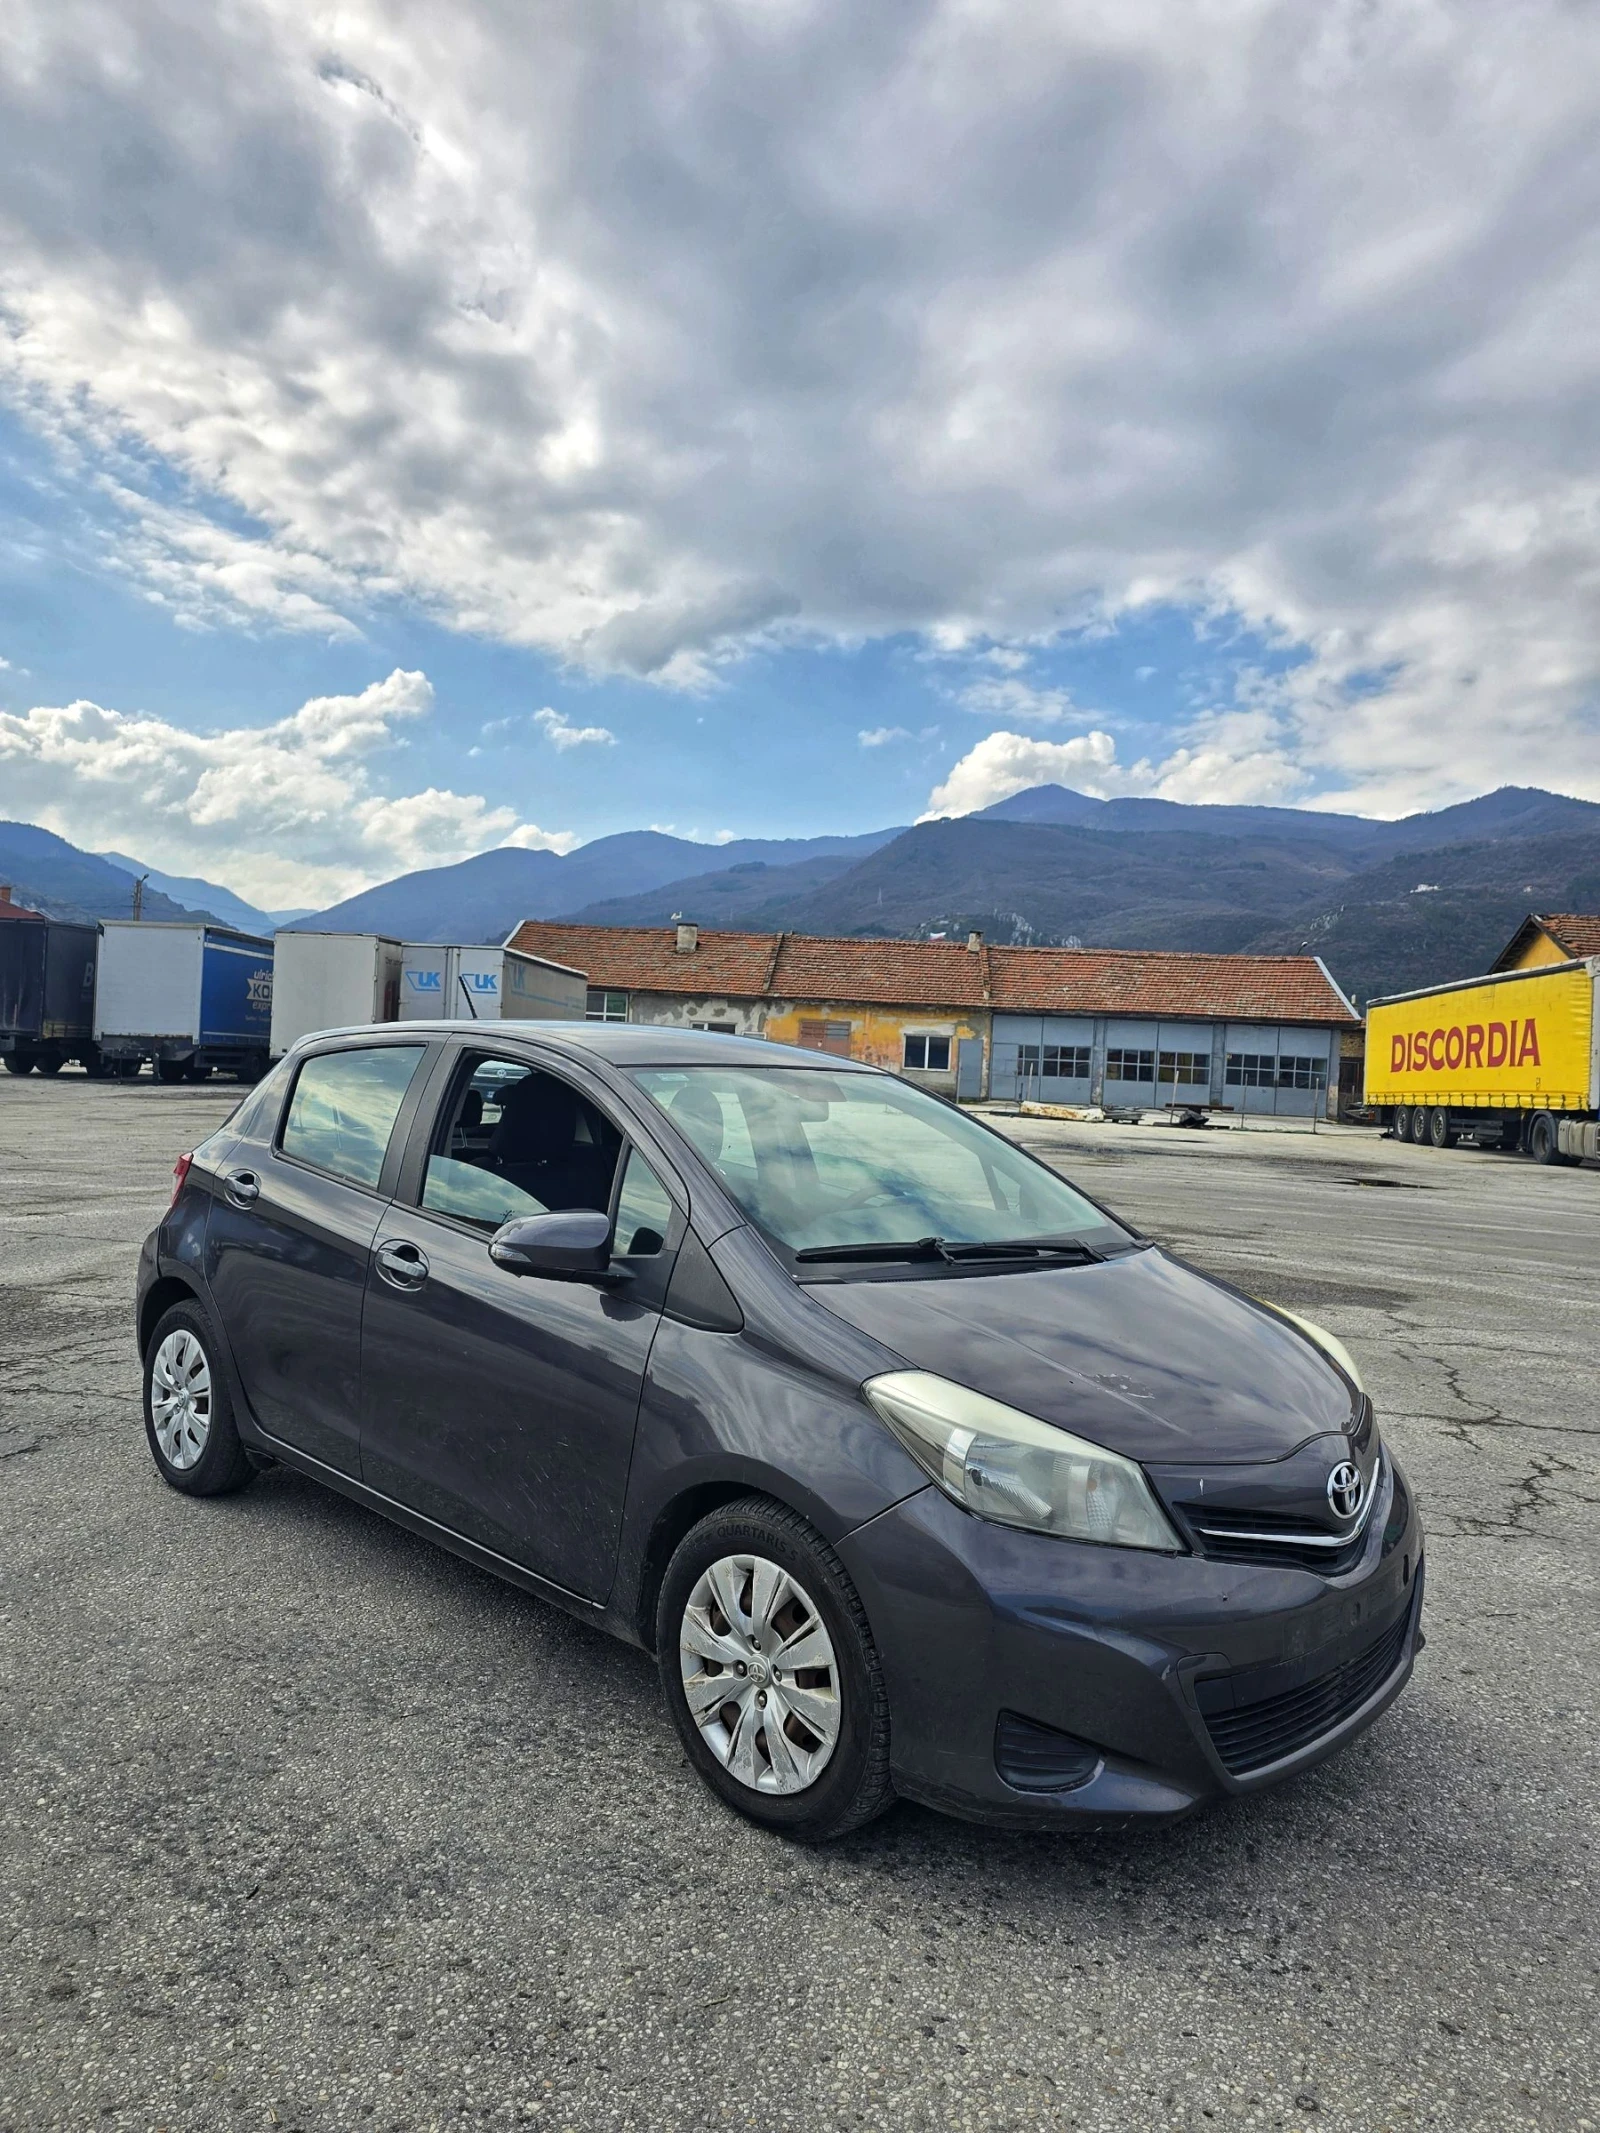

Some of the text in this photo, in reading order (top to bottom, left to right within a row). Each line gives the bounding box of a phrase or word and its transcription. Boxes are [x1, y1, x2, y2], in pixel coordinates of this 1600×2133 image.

[253, 968, 273, 981] ulric
[418, 972, 441, 987] UK
[475, 974, 497, 989] UK
[1390, 1018, 1541, 1073] DISCORDIA
[717, 1525, 788, 1552] QUARTARIS
